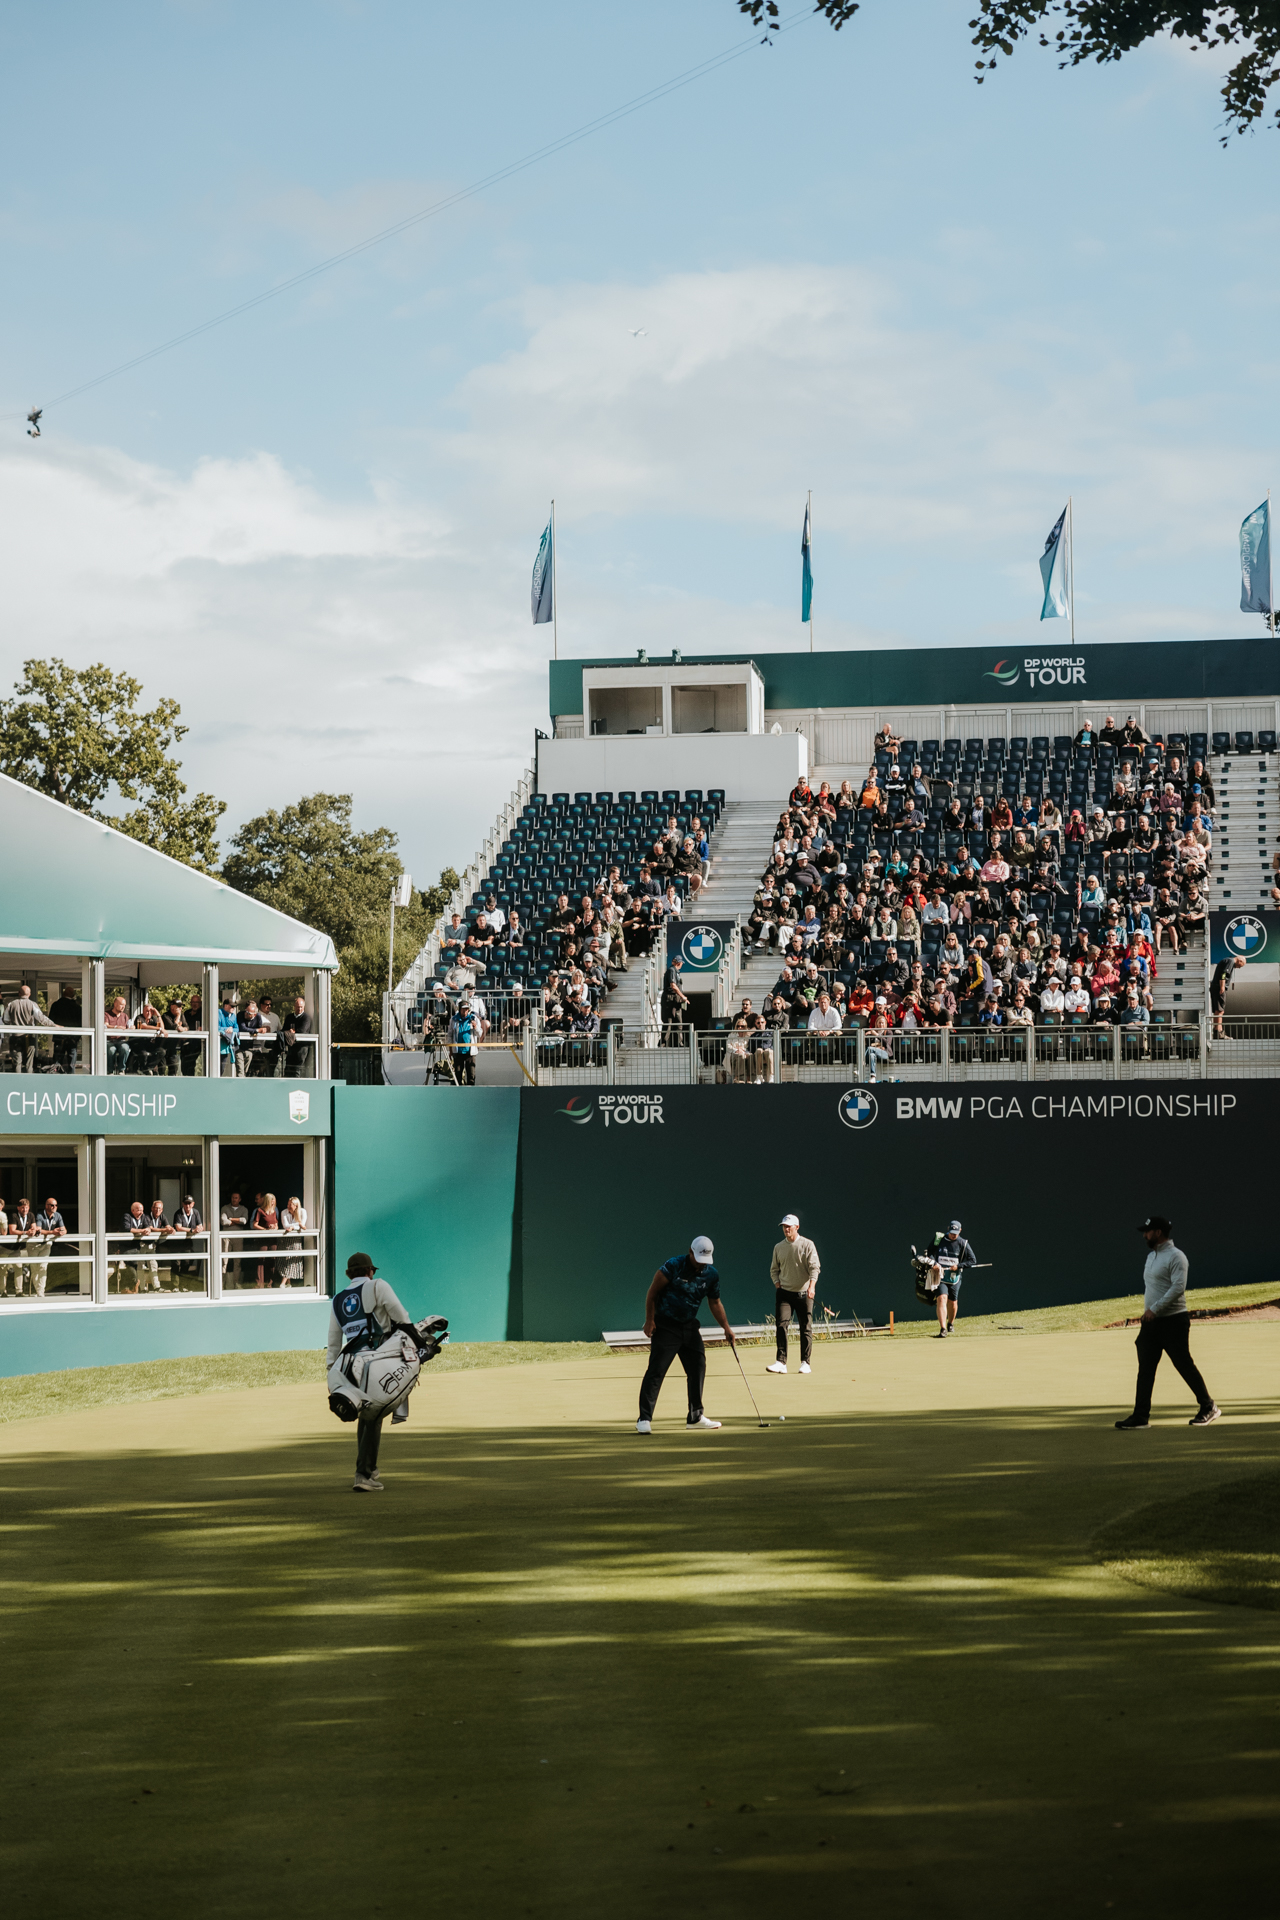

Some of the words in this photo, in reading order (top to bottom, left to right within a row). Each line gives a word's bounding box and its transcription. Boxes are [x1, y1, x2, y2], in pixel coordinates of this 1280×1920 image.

[1023, 658, 1041, 668] DP
[1041, 657, 1086, 667] WORLD
[1024, 667, 1087, 689] TOUR
[1229, 917, 1262, 930] BMW
[687, 928, 718, 940] BMW
[598, 1095, 616, 1105] DP
[616, 1094, 664, 1105] WORLD
[843, 1090, 873, 1103] BMW
[6, 1091, 178, 1117] CHAMPIONSHIP
[896, 1096, 963, 1119] BMW
[969, 1096, 1025, 1119] PGA
[1031, 1093, 1238, 1119] CHAMPIONSHIP
[598, 1104, 666, 1128] TOUR
